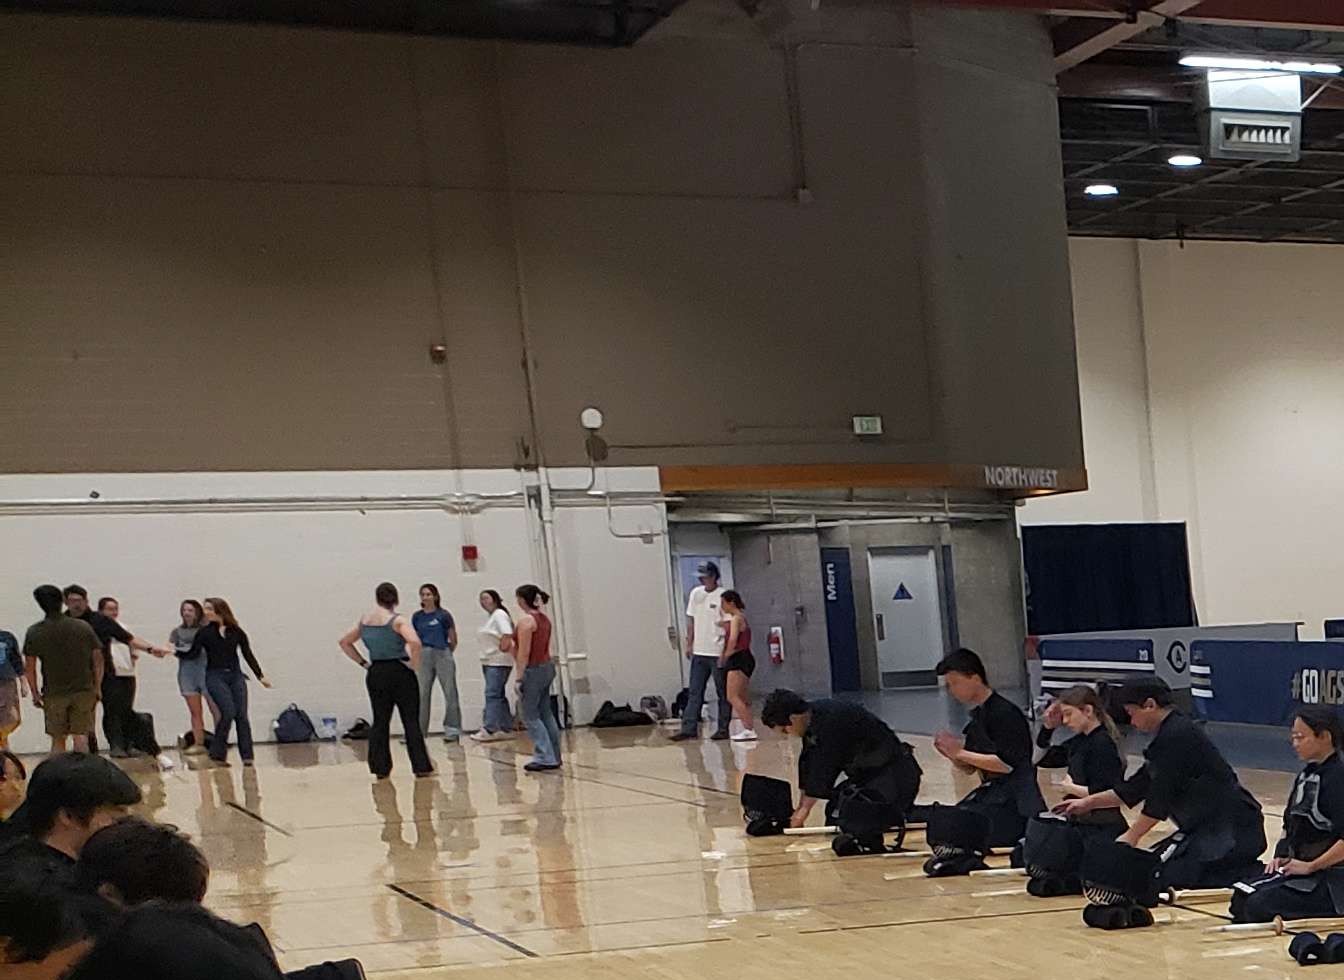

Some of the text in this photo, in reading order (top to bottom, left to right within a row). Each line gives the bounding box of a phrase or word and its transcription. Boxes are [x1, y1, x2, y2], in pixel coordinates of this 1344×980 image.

[985, 465, 1058, 488] NORTHWEST
[826, 563, 837, 601] Men
[1291, 668, 1344, 705] #GOAGS
